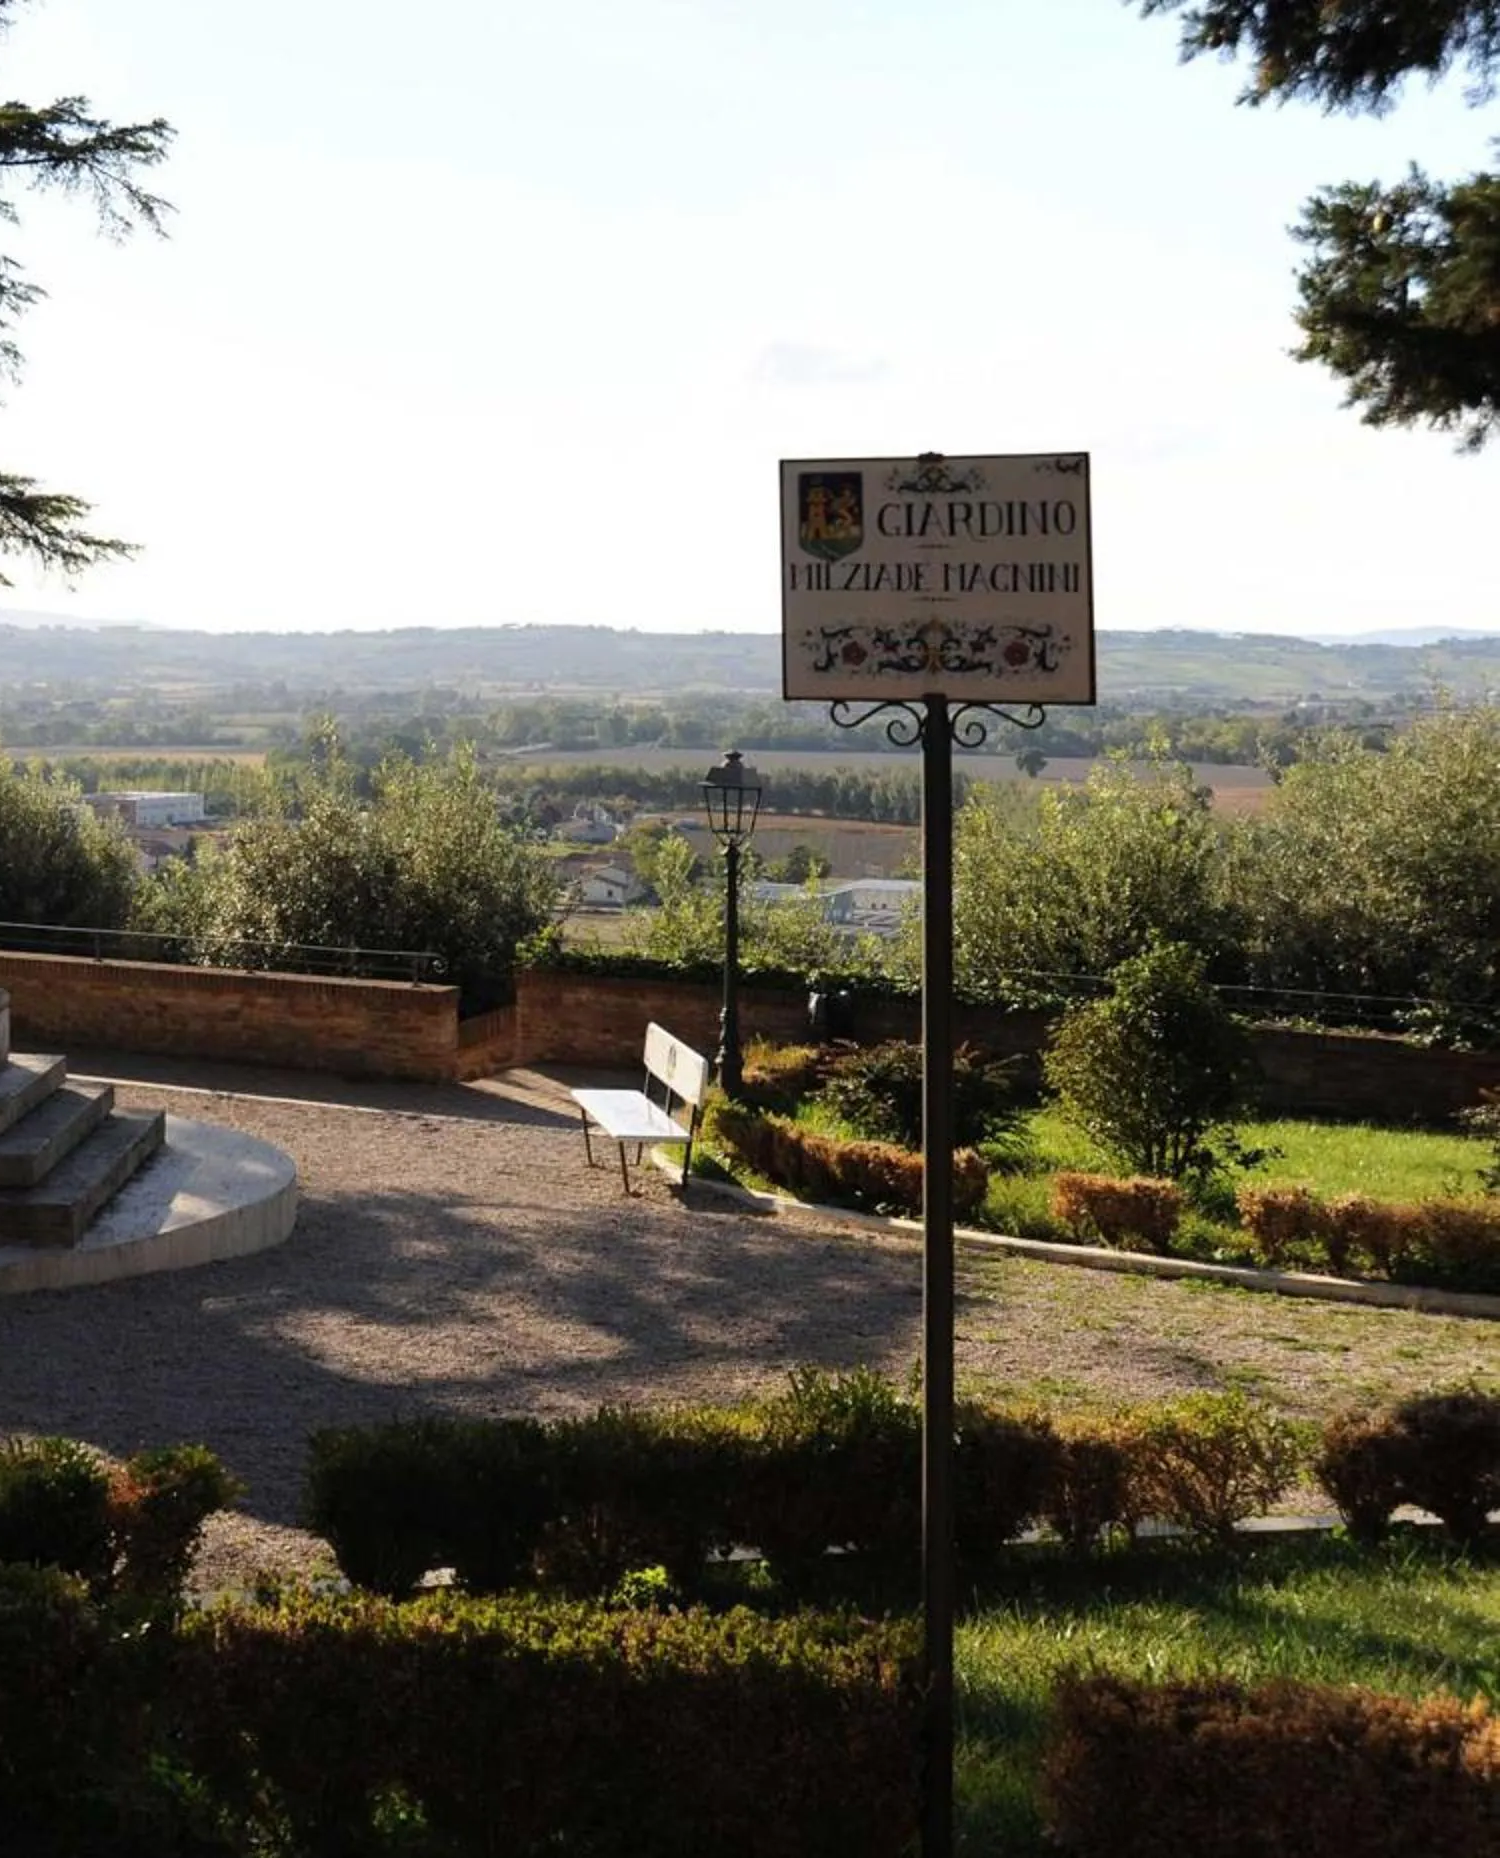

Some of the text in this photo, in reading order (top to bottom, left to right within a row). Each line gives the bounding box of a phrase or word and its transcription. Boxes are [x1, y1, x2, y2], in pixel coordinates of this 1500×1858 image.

[876, 500, 1077, 541] GIARDINO
[790, 562, 1080, 593] MILZIADE MAGNINI
